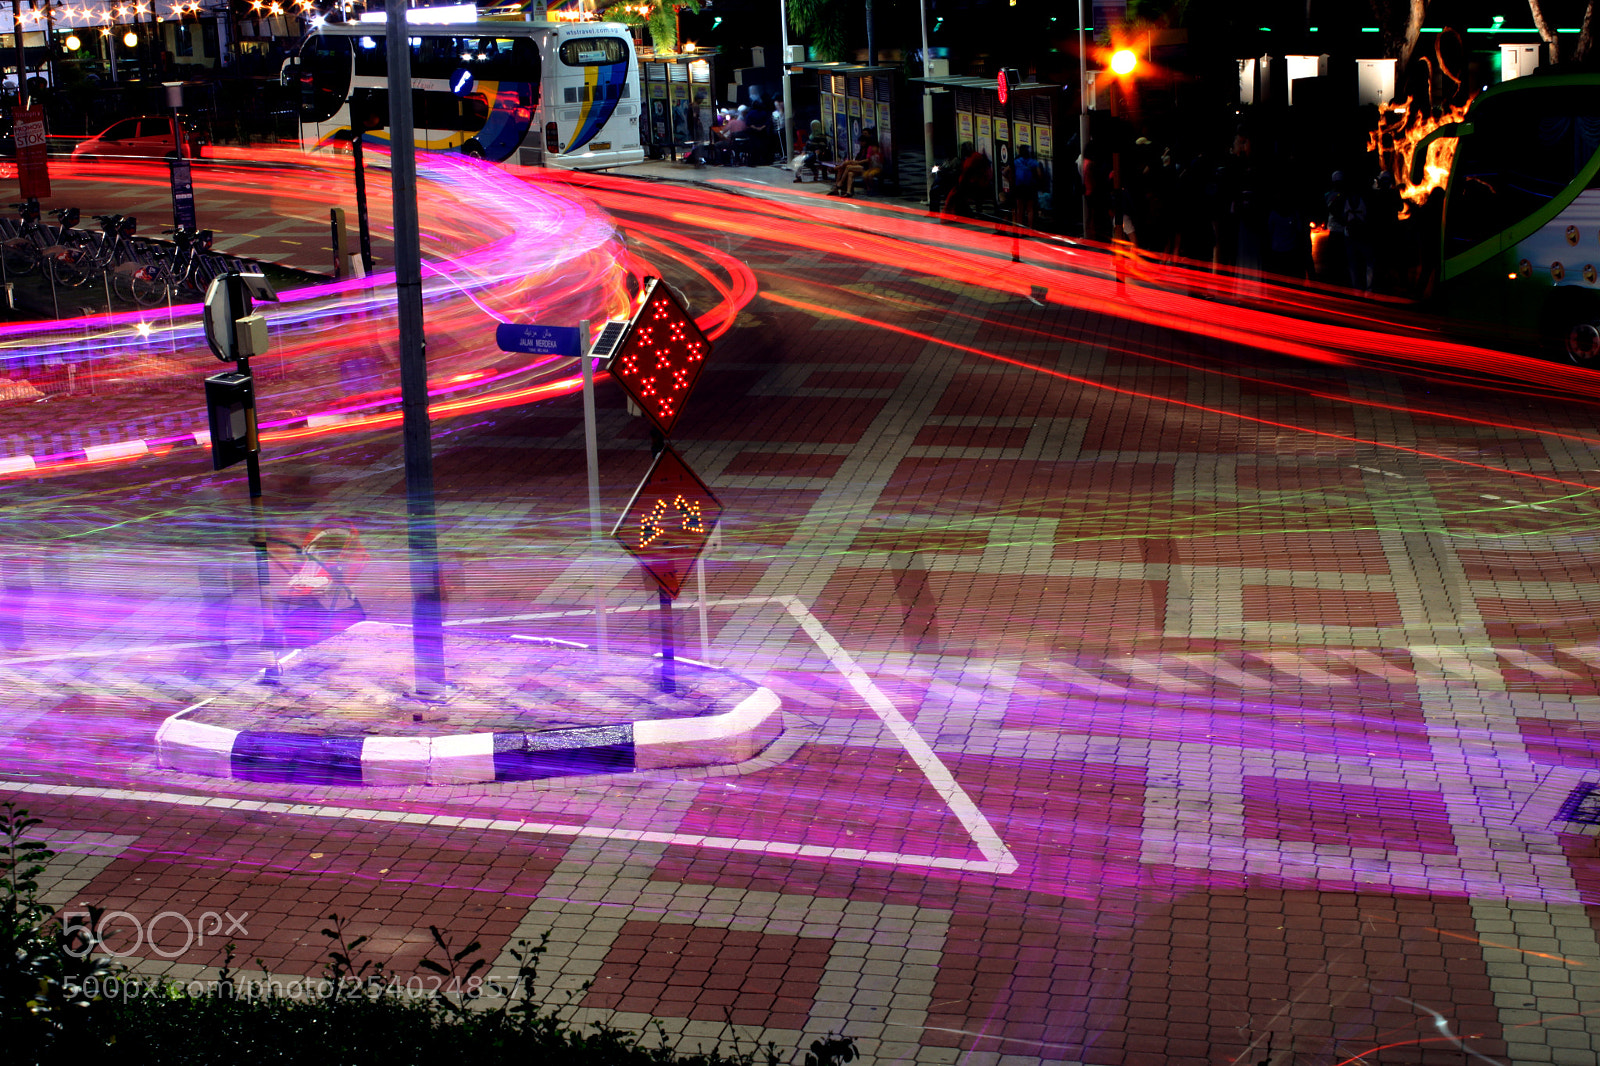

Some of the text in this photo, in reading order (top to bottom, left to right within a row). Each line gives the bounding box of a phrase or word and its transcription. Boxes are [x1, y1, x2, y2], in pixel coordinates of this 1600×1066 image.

[17, 134, 45, 146] STOK
[519, 338, 557, 349] JALAN MERDEKA
